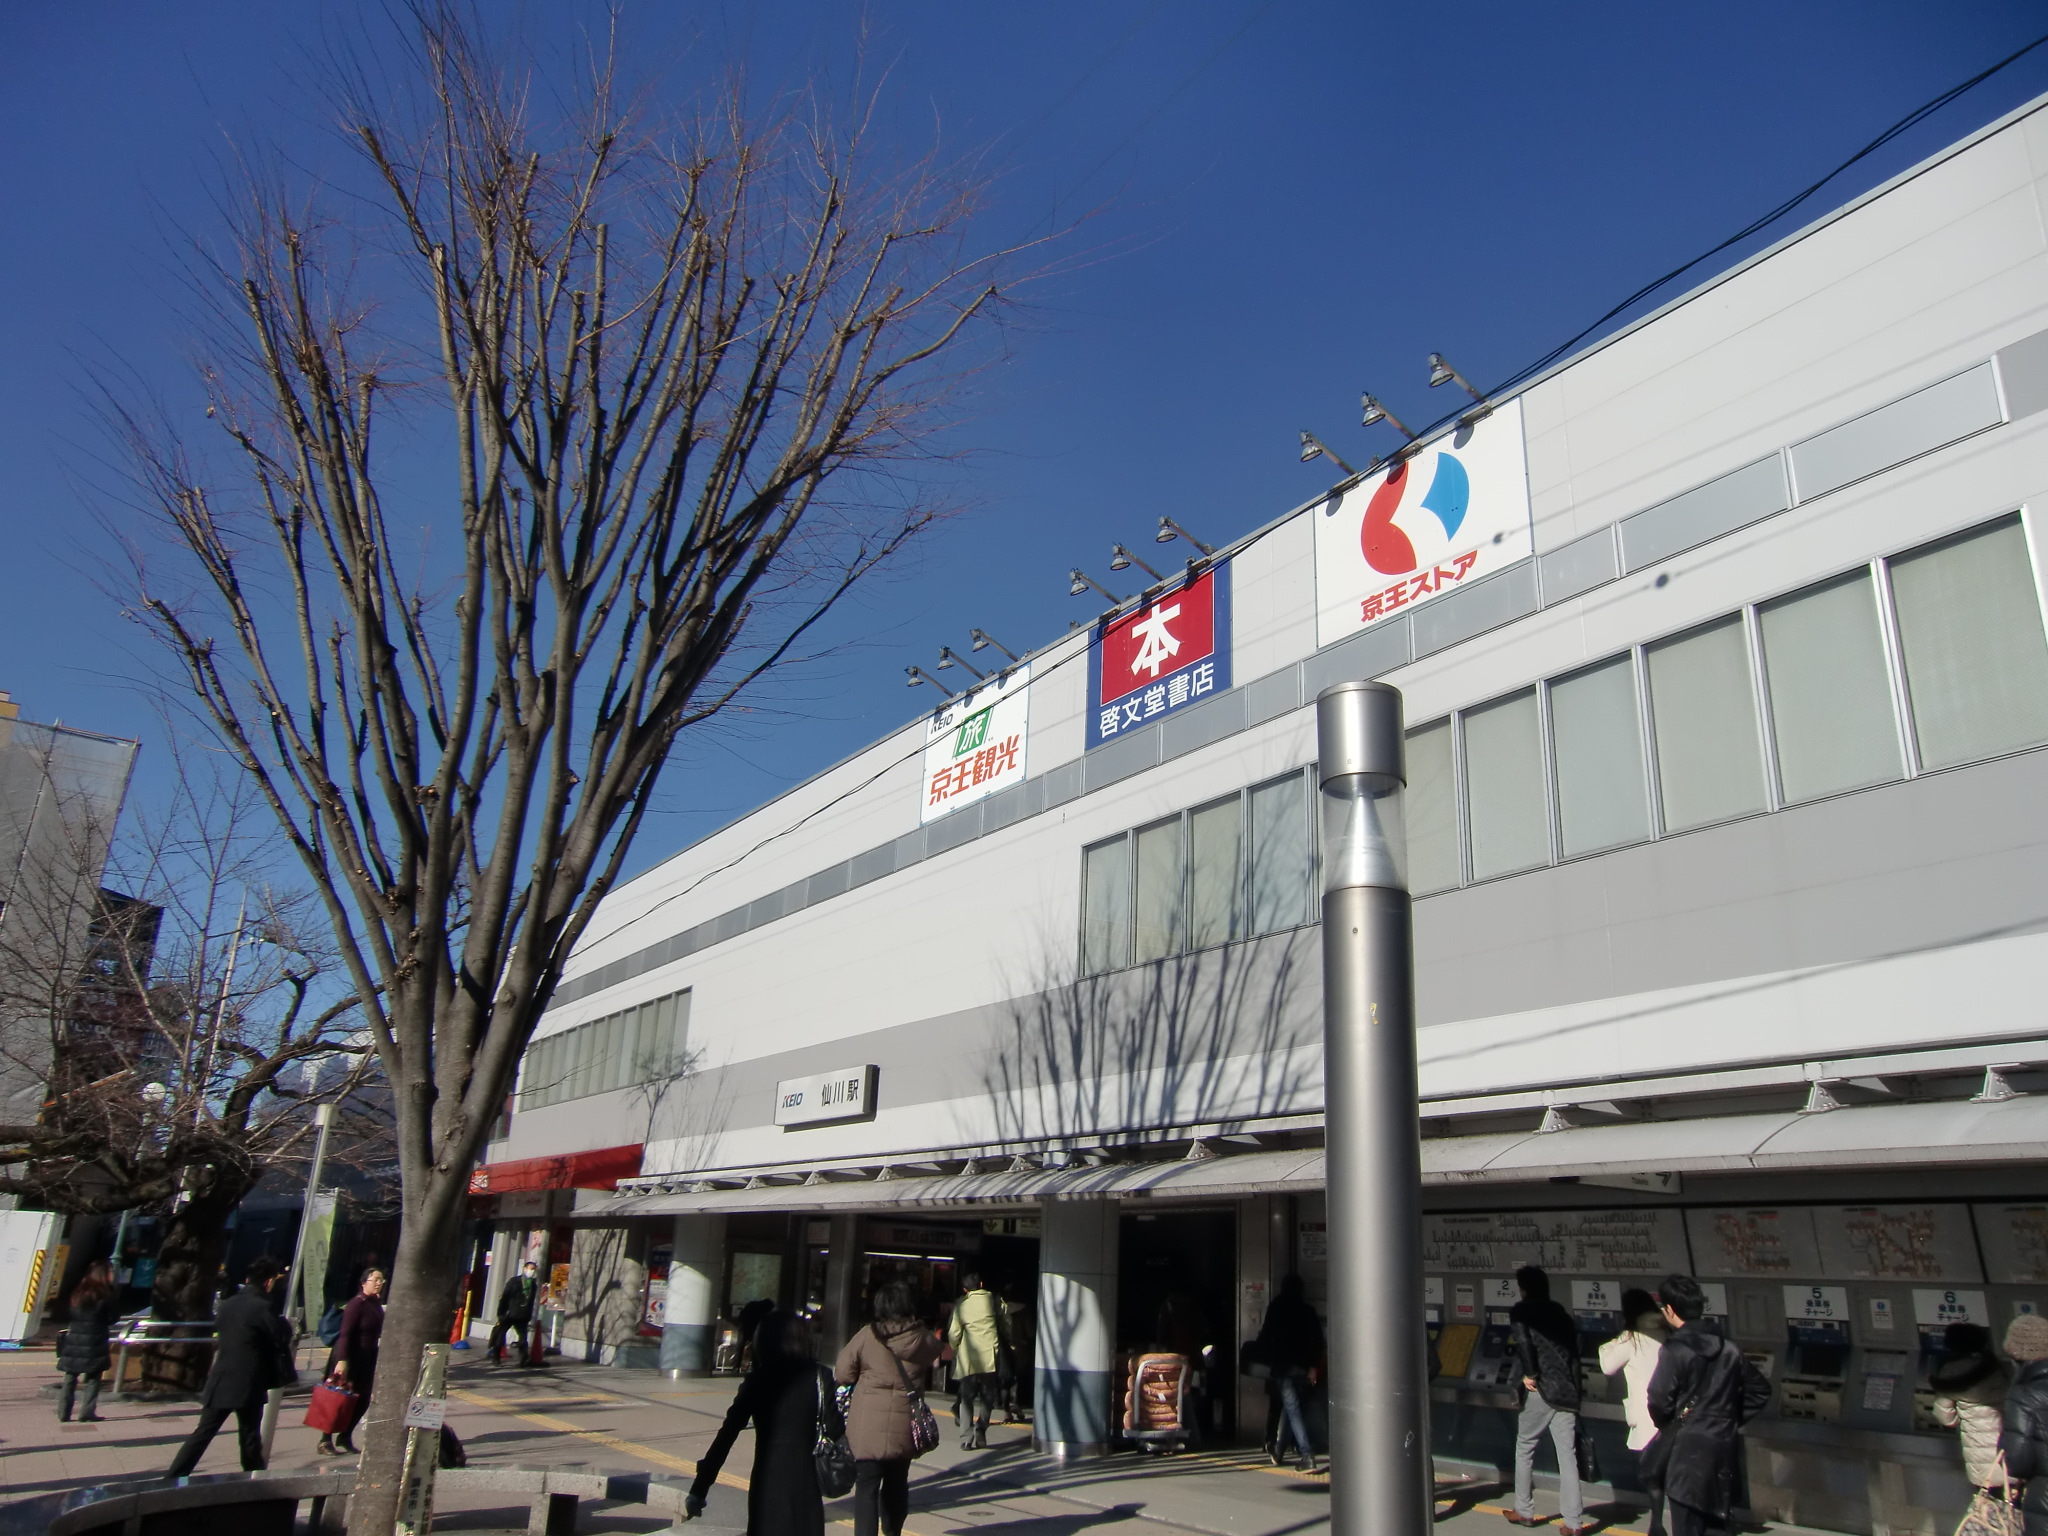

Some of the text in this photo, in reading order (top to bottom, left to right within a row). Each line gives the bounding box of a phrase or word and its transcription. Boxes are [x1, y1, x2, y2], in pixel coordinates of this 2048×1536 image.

[1361, 549, 1478, 622] 京王ストア
[1131, 603, 1181, 678] 本
[1100, 662, 1214, 738] 啓文堂書店
[930, 713, 954, 734] KEIO
[958, 712, 988, 753] 旅
[929, 734, 1020, 806] 京王観光
[782, 1079, 859, 1109] KEIO 仙川駅
[1502, 1280, 1509, 1290] 2
[1592, 1282, 1600, 1292] 3
[1812, 1287, 1822, 1299] 5
[1496, 1290, 1516, 1298] チャージ
[1944, 1291, 1956, 1304] 6
[1805, 1308, 1834, 1317] チャージ
[1937, 1313, 1970, 1323] チャージ
